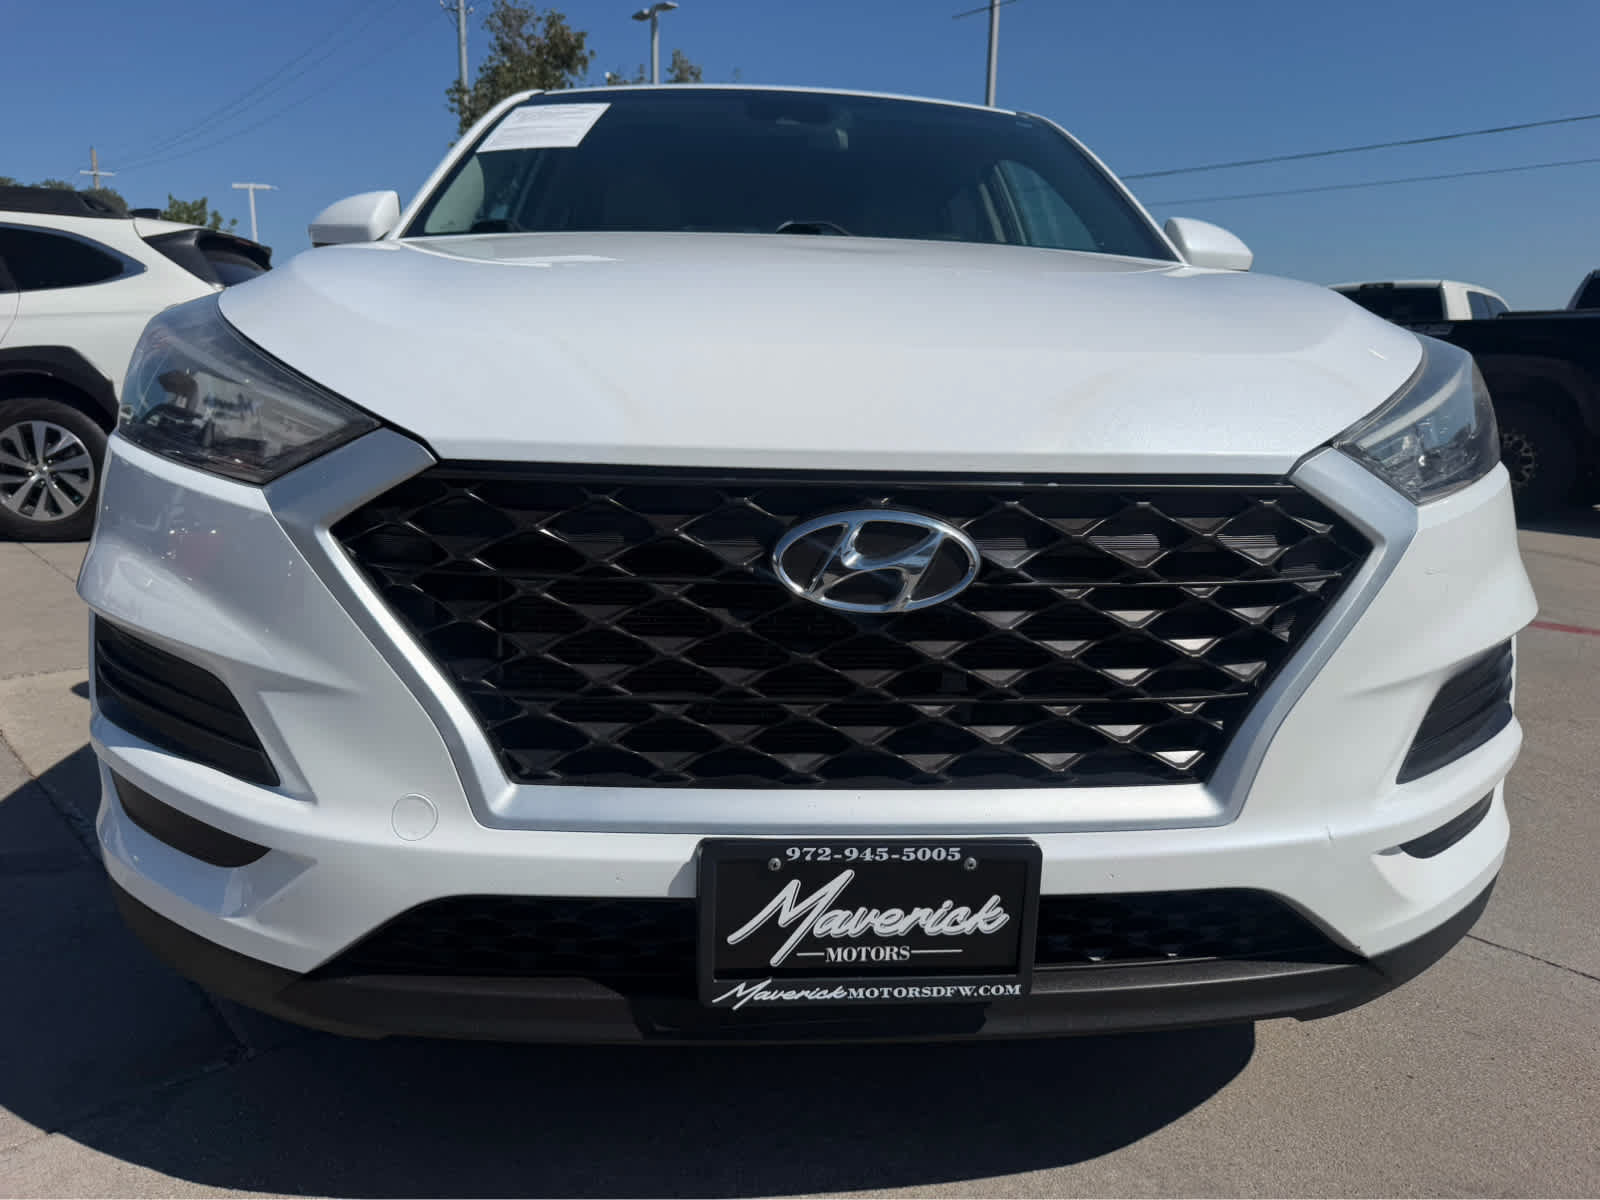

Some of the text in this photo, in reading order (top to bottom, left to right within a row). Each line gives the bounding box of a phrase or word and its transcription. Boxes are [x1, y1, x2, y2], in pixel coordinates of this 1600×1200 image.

[786, 847, 961, 862] 972-945-5005
[727, 869, 1010, 967] Maverick
[825, 946, 911, 962] MOTORS
